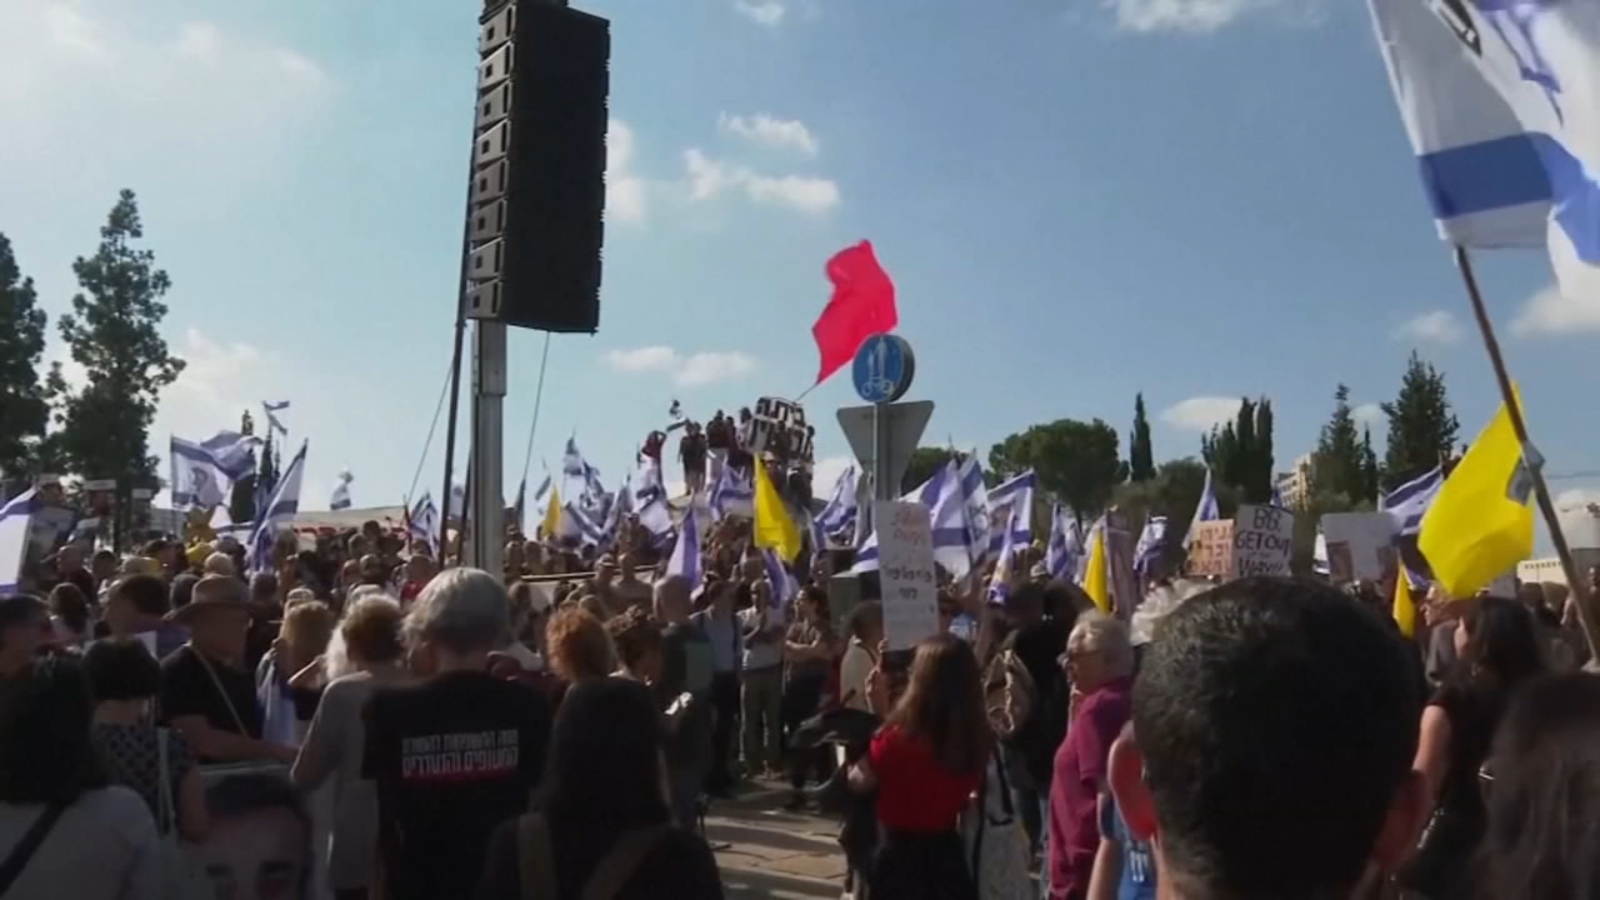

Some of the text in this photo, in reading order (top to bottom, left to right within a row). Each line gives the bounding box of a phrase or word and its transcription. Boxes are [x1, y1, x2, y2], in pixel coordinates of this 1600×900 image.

[1235, 529, 1264, 550] GET
[403, 746, 519, 778] החטופים והנעדרים
